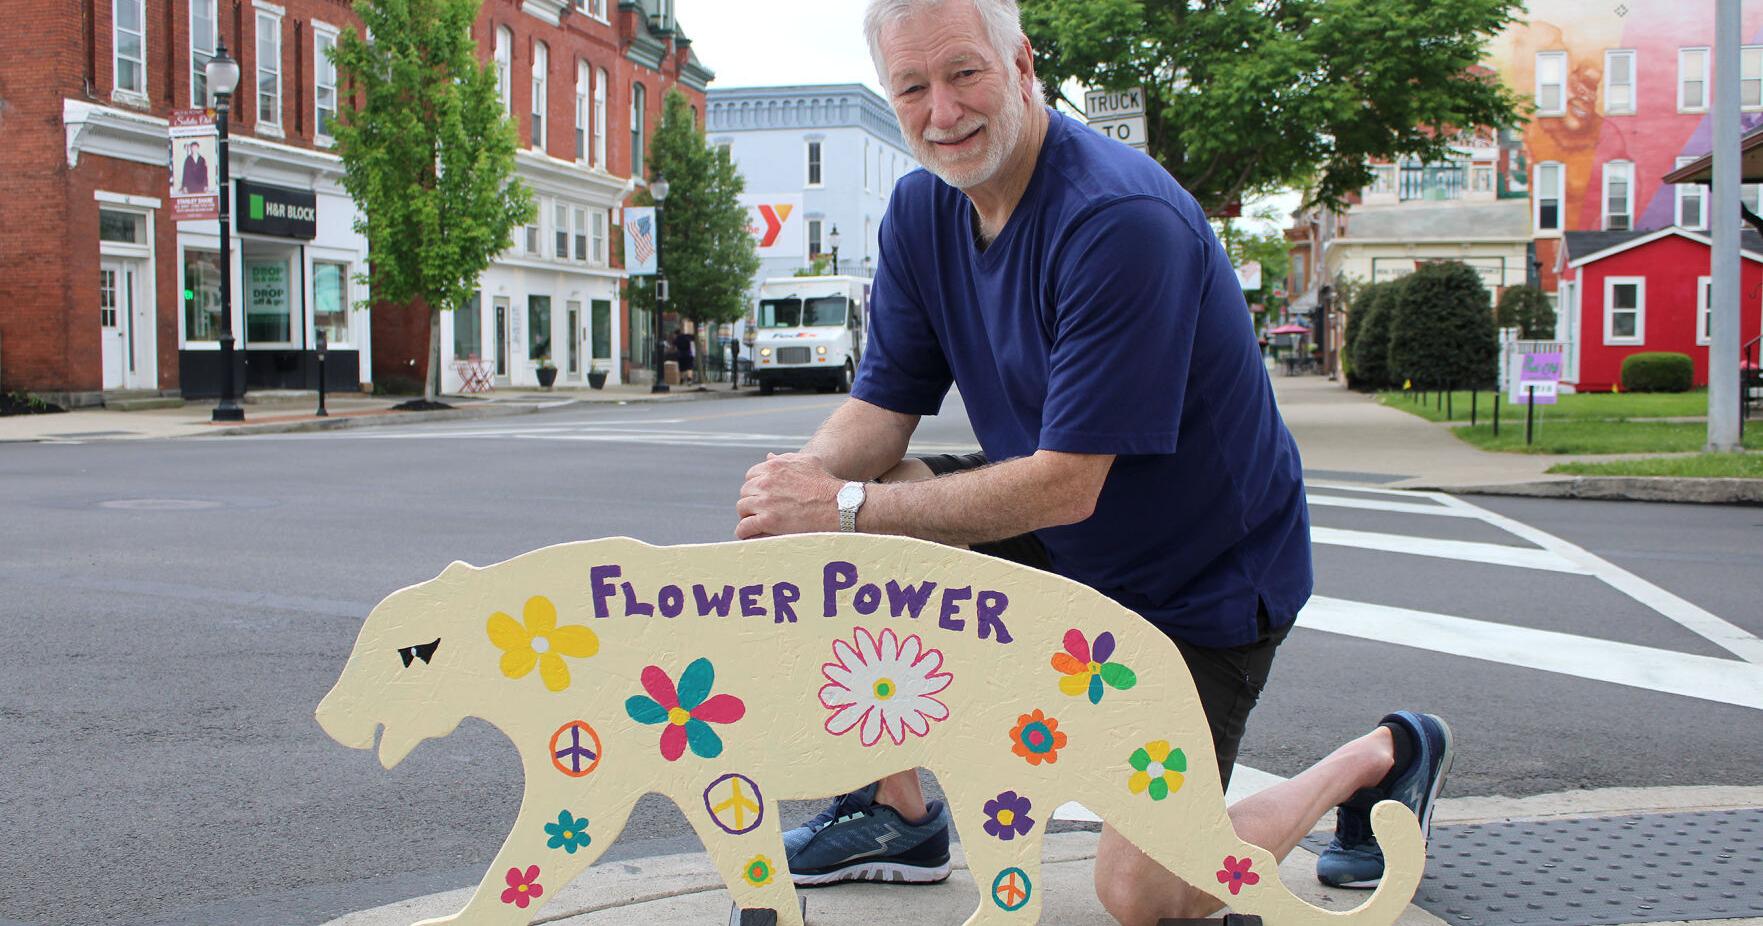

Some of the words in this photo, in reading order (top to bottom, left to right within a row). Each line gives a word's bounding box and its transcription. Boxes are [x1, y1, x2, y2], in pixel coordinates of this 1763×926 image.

[1089, 92, 1140, 113] TRUCK
[1102, 124, 1130, 140] TO
[266, 201, 286, 218] H&R
[287, 204, 316, 222] BLOCK
[252, 266, 283, 276] DROP
[253, 288, 284, 298] DROP
[590, 564, 801, 624] FLOWER
[823, 561, 1014, 644] POWER
